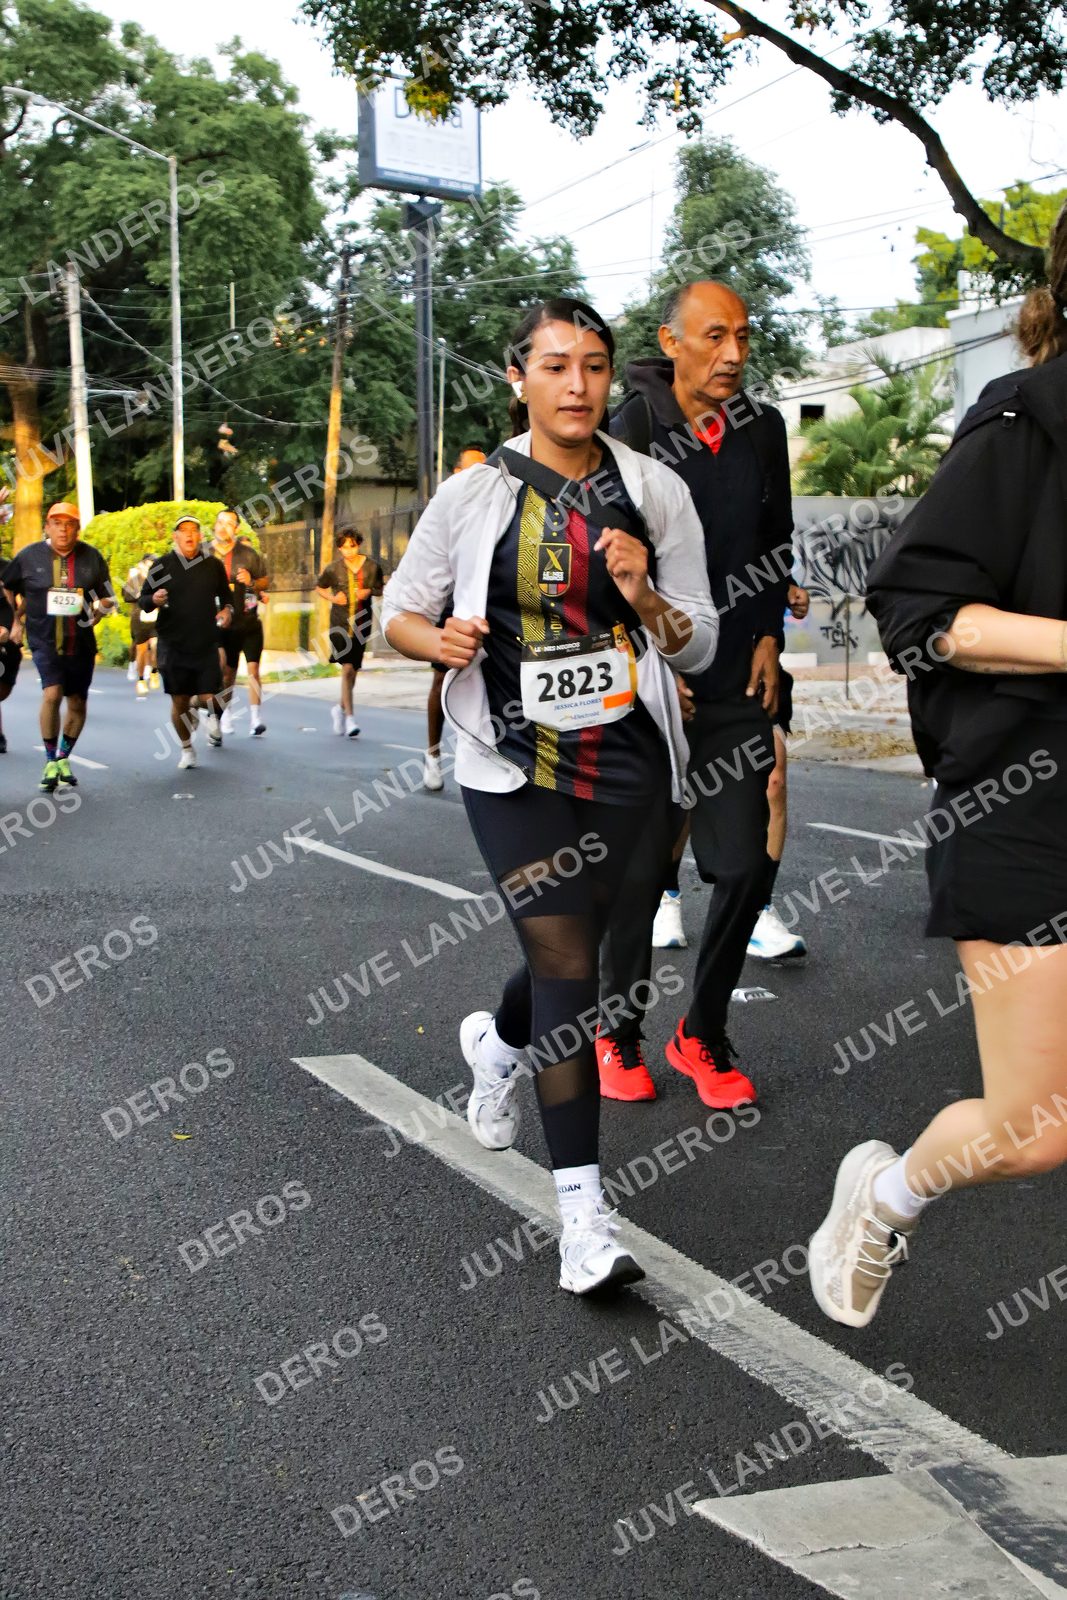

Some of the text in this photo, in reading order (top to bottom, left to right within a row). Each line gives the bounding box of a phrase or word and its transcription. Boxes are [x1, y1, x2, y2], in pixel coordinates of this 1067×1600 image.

[53, 596, 76, 605] 4252
[537, 661, 613, 702] 2823
[555, 702, 578, 711] JESSICA
